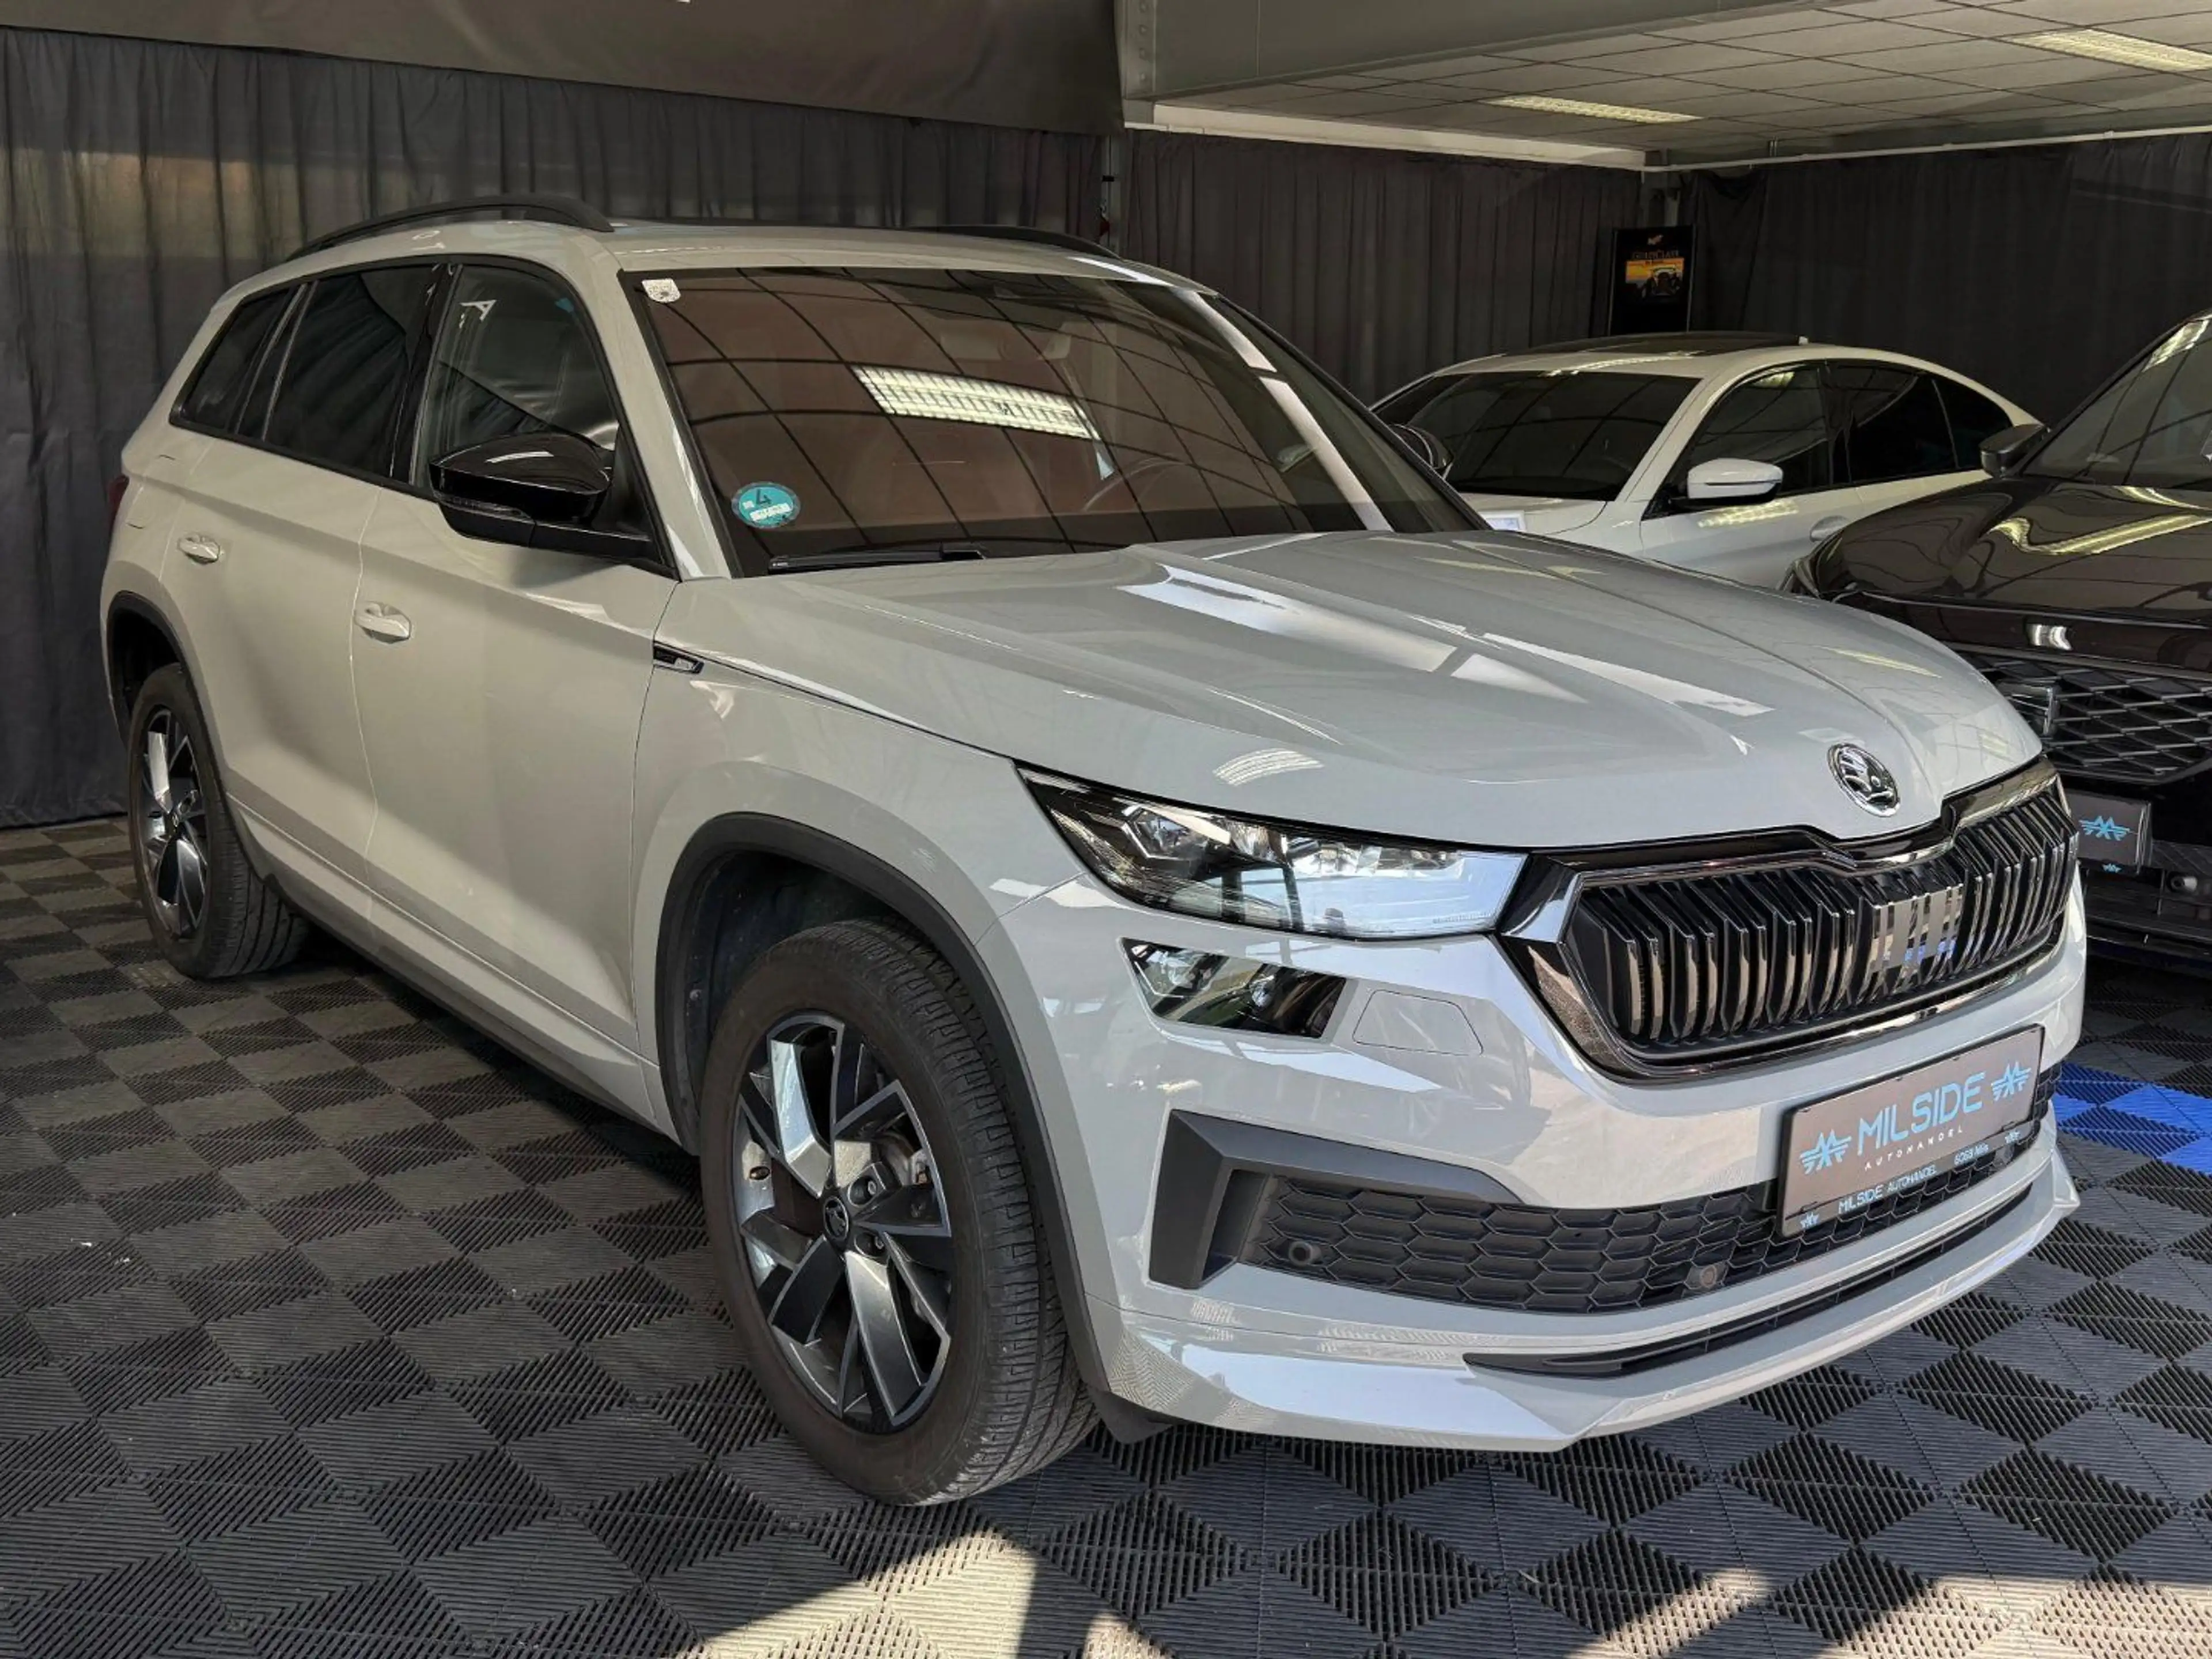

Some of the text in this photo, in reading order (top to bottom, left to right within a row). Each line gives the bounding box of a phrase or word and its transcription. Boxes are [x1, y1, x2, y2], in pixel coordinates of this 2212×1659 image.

[755, 488, 772, 505] 4
[1857, 1071, 1986, 1156] MILSIDE
[1865, 1125, 1963, 1172] AUTOHANDEL
